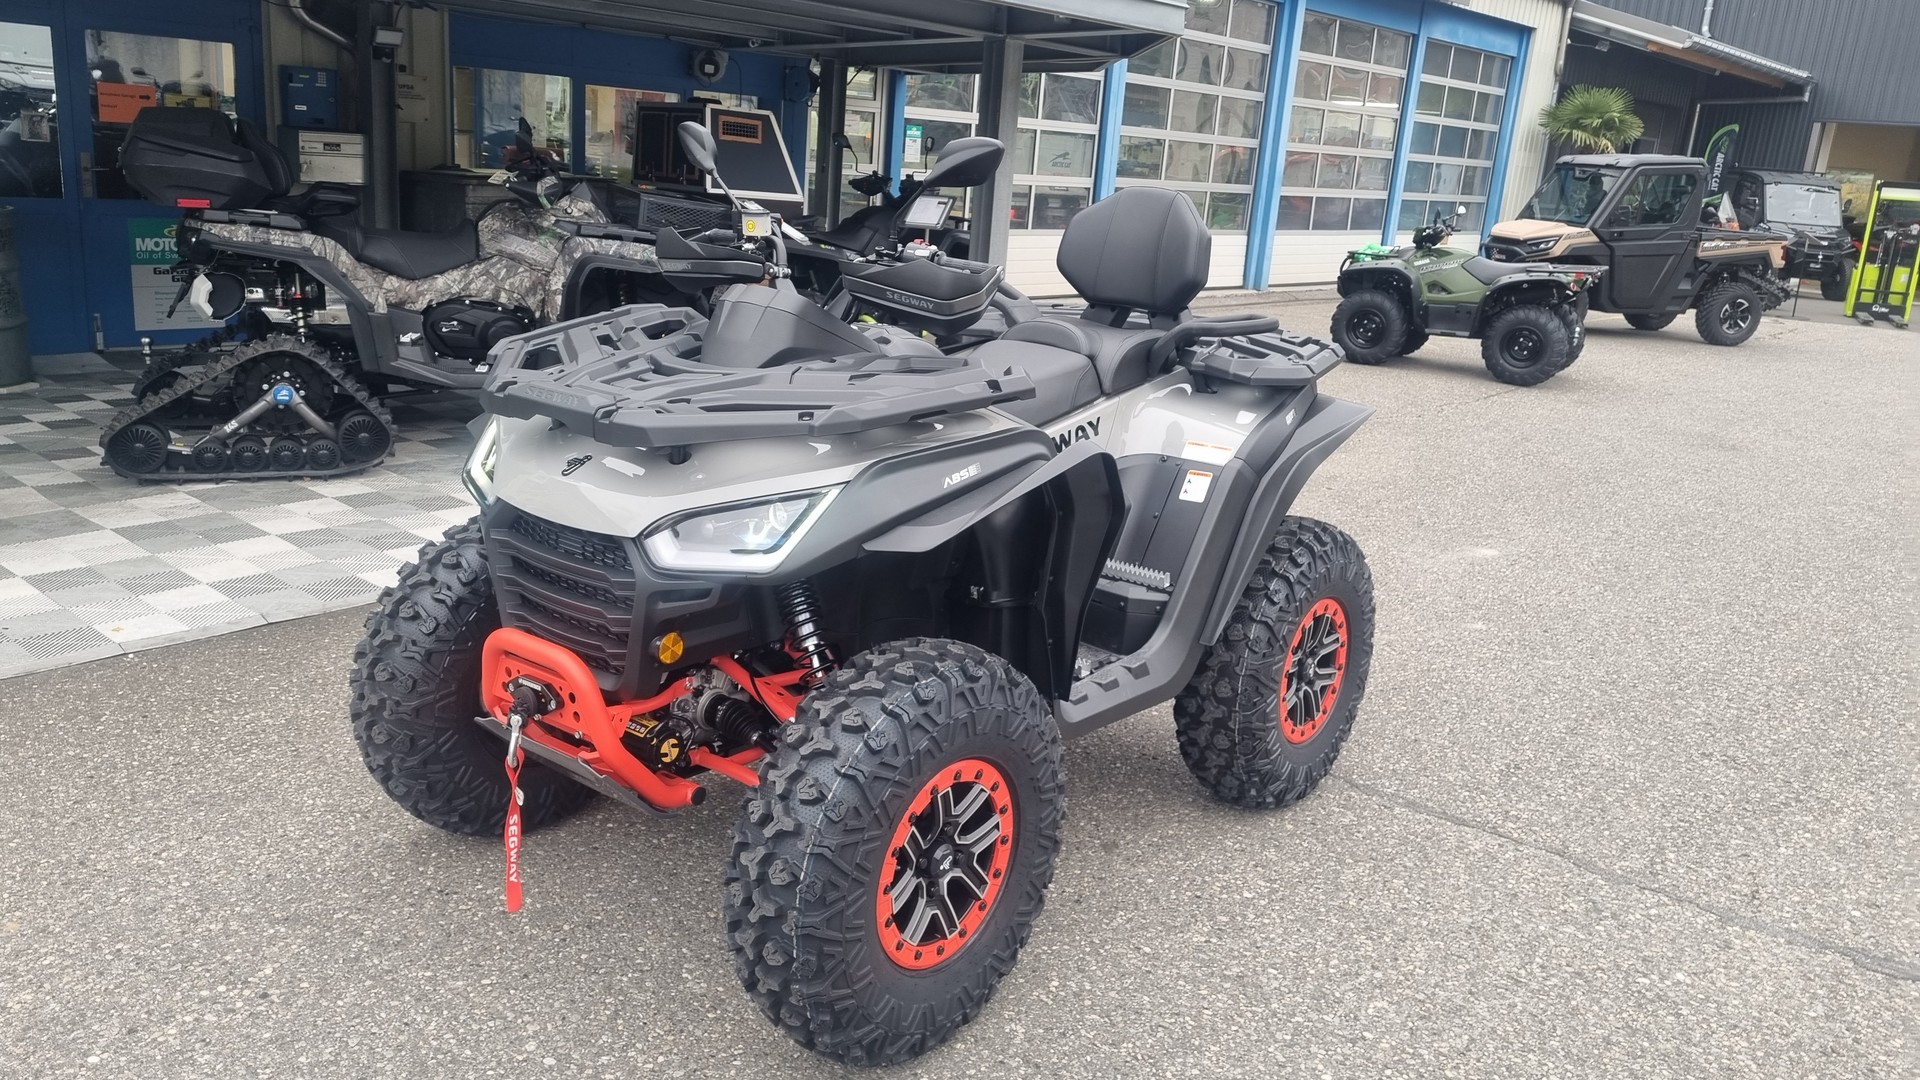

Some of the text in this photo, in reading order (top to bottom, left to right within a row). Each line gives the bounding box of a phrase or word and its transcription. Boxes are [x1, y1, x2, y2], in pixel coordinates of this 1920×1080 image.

[1710, 152, 1725, 192] ARCTIC CAT
[135, 237, 178, 251] MOTO
[136, 251, 180, 259] Oil of Sw
[886, 291, 934, 309] SEGWAY
[1051, 416, 1101, 454] WAY
[508, 814, 518, 883] SEGWAY
